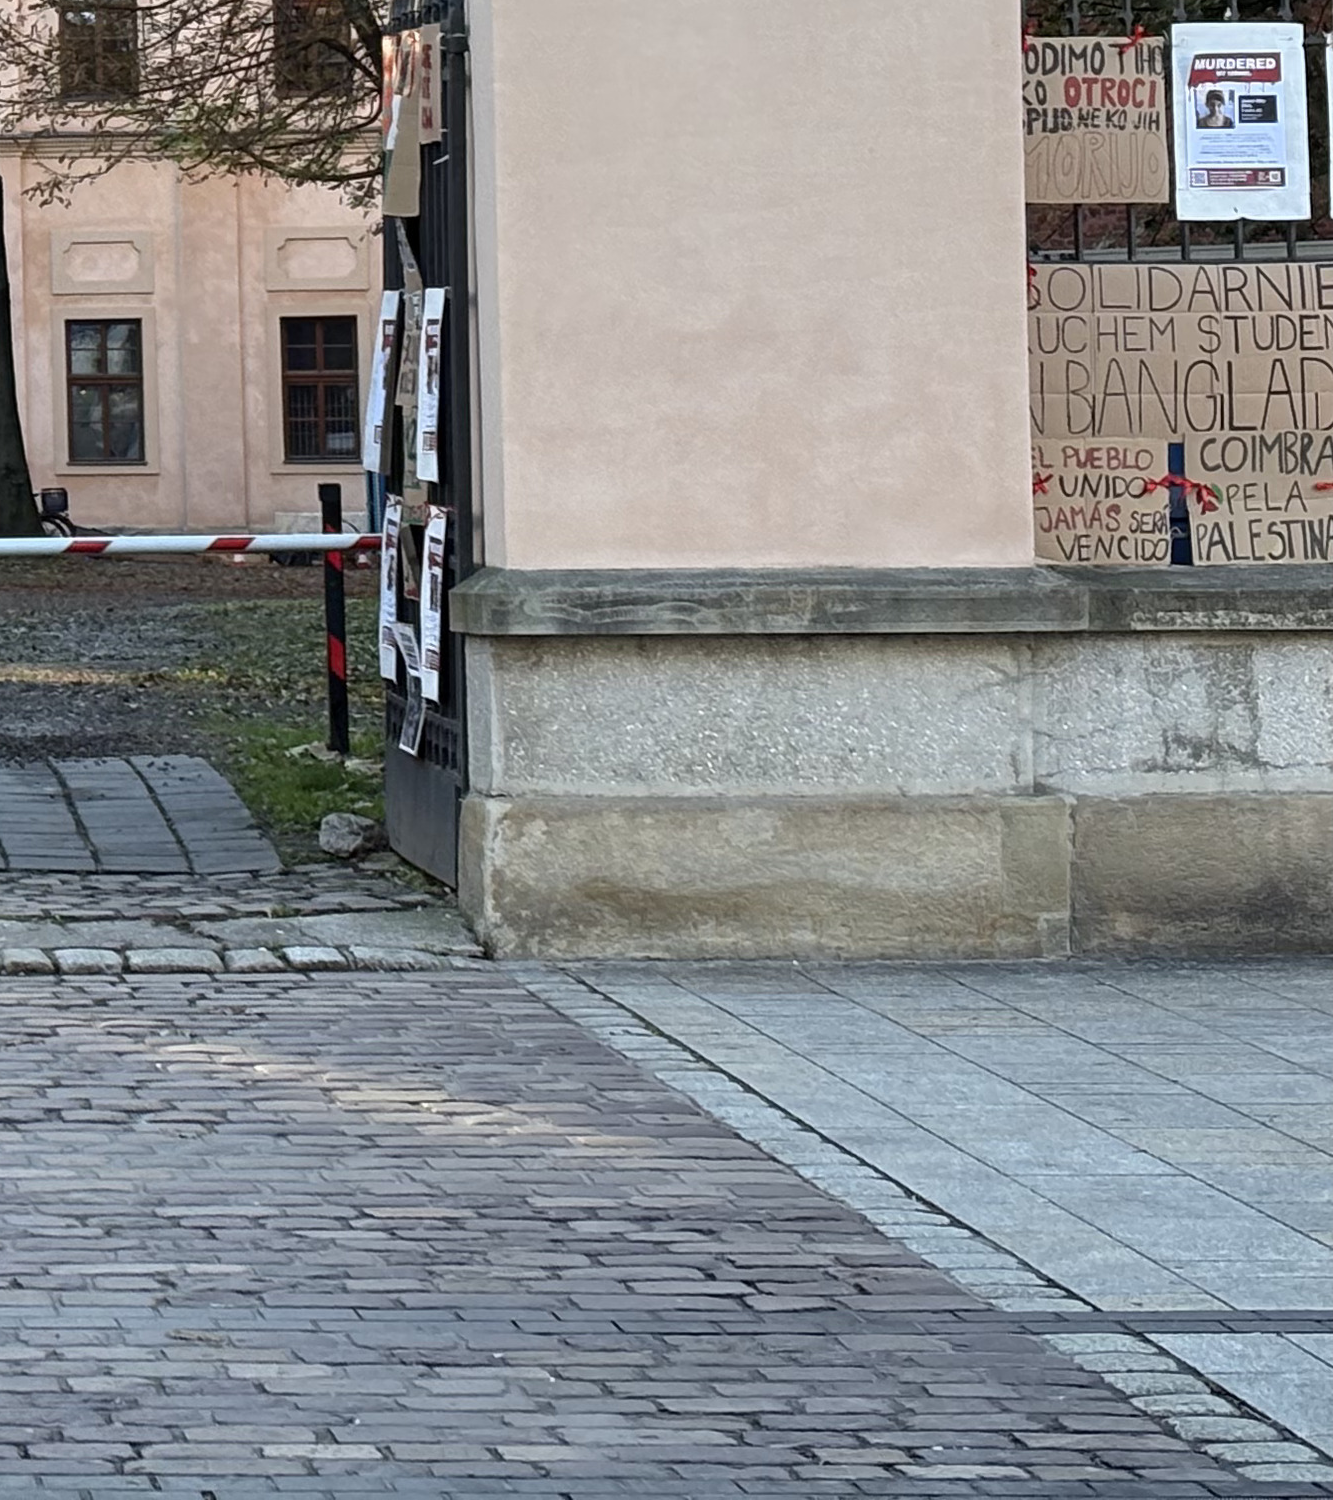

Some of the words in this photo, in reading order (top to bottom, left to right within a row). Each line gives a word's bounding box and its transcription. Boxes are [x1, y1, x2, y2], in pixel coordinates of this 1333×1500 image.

[1194, 58, 1276, 70] MURDERED
[1064, 76, 1157, 108] OTROCI
[1023, 108, 1075, 135] PIJO,
[1106, 109, 1127, 129] KO
[1133, 111, 1160, 132] JIH
[1028, 315, 1176, 353] UCHEM
[1062, 445, 1154, 471] PUEBLO
[1200, 431, 1333, 475] COIMBRA
[1059, 474, 1147, 499] UNIDO
[1226, 481, 1307, 515] PELA
[1035, 501, 1121, 533] JAMÁS
[1057, 535, 1169, 561] VENCIDO
